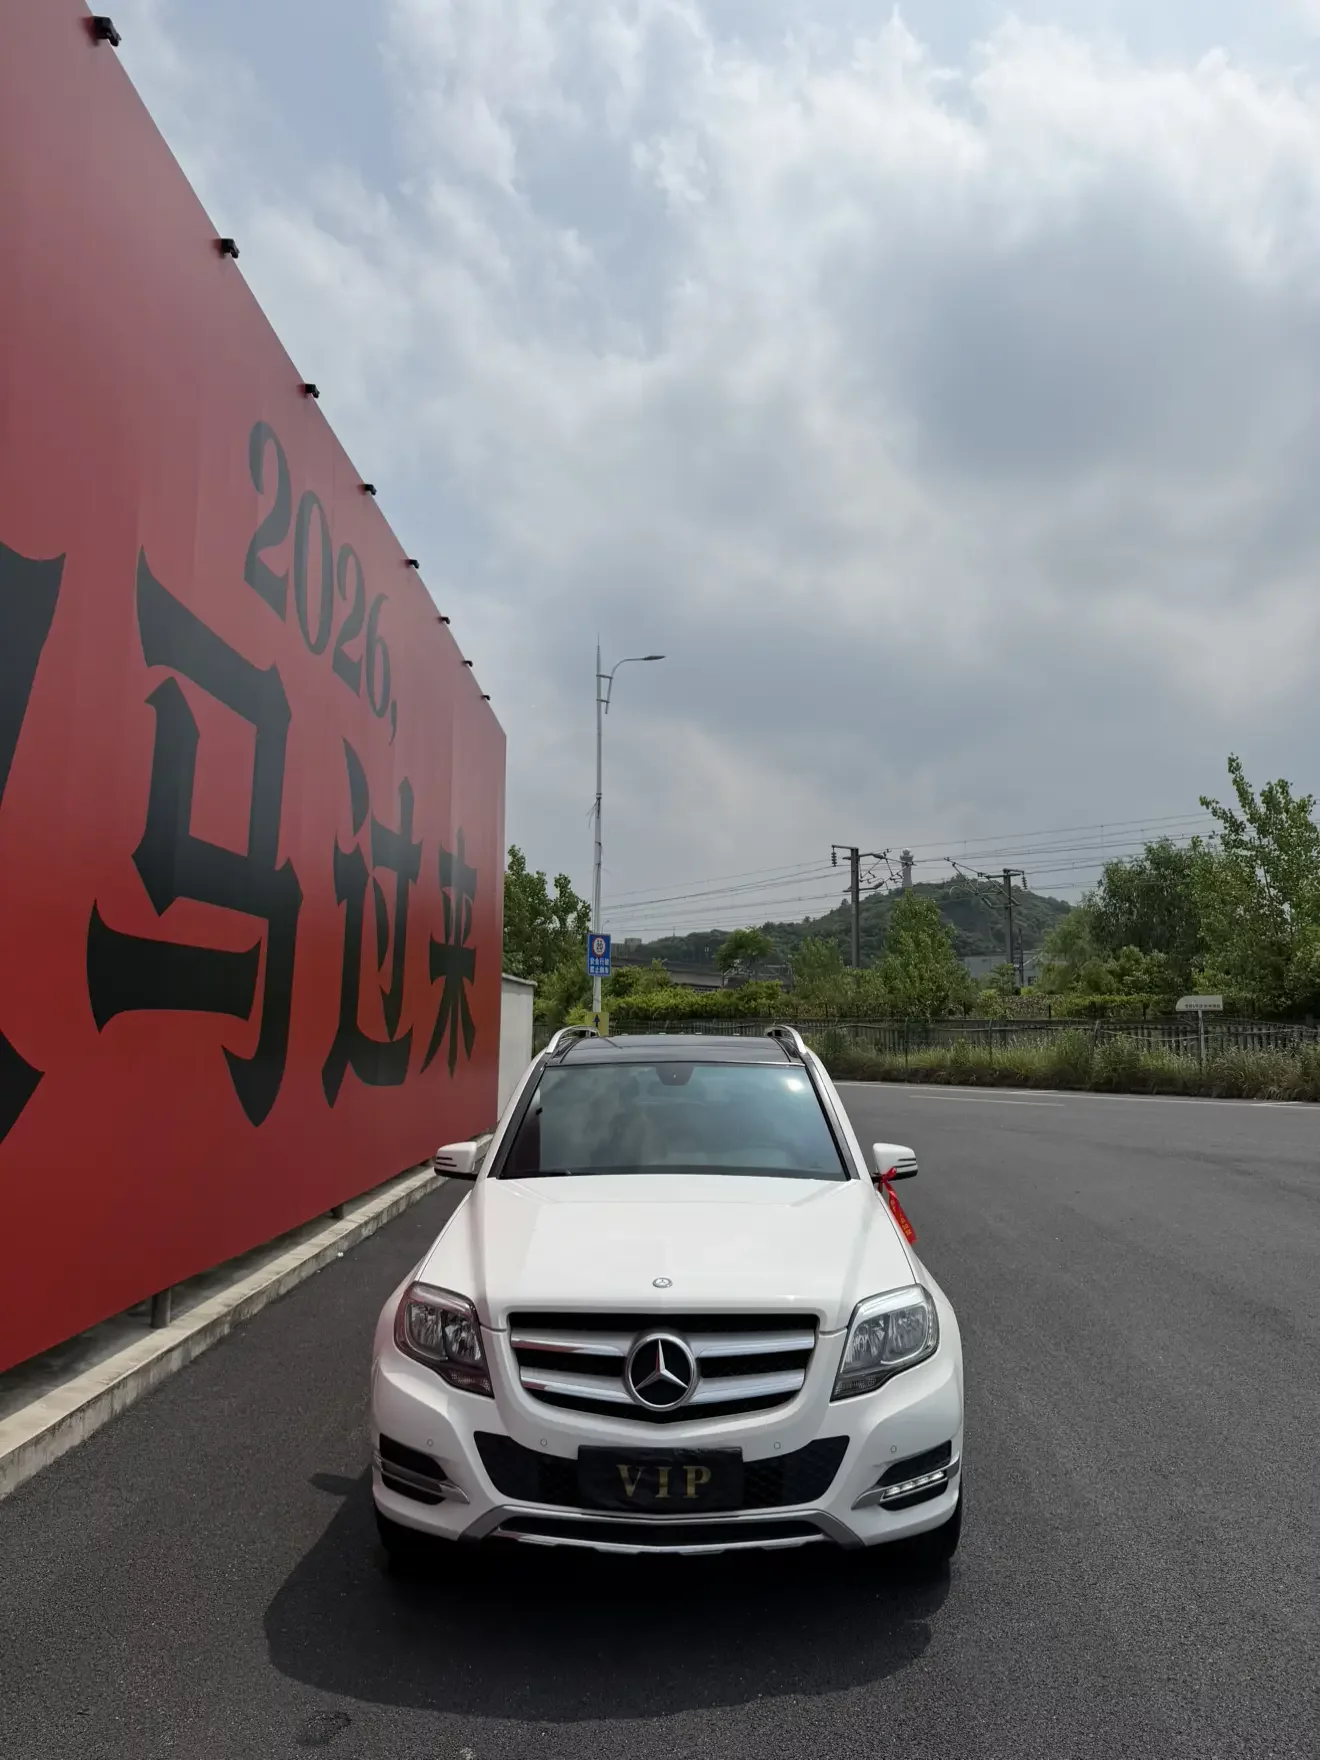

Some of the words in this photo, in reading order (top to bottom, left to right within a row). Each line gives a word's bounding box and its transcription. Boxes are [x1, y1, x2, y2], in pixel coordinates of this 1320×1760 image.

[244, 421, 397, 745] 2026,
[0, 541, 477, 1145] 马过来
[616, 1464, 712, 1498] VIP
